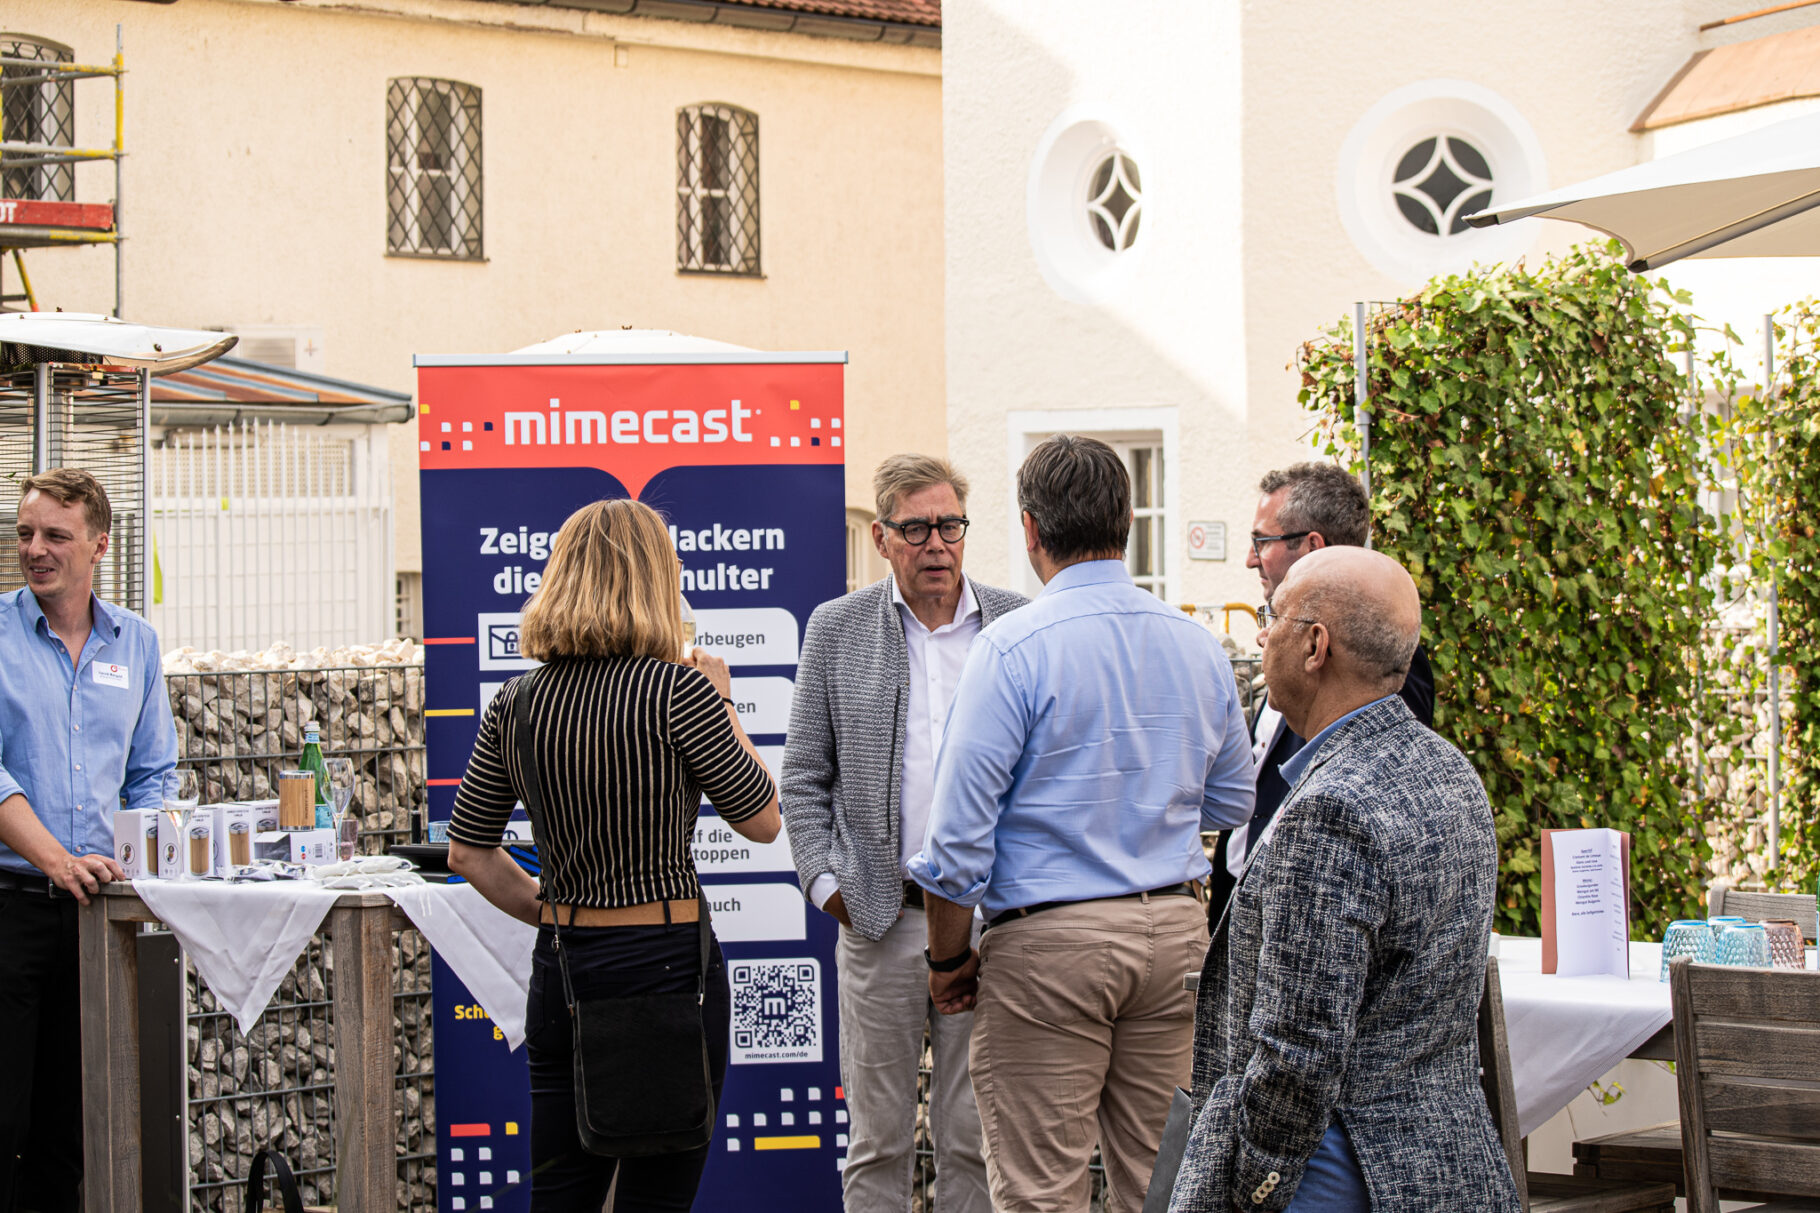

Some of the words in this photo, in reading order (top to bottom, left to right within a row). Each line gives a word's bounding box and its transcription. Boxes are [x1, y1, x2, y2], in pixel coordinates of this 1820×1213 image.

[504, 398, 753, 445] mimecast
[493, 566, 542, 594] die
[680, 563, 774, 591] hulter
[694, 632, 765, 648] rbeugen
[734, 702, 756, 713] en
[708, 829, 732, 843] die
[694, 848, 750, 863] toppen
[745, 1051, 808, 1060] mimecast.com/de
